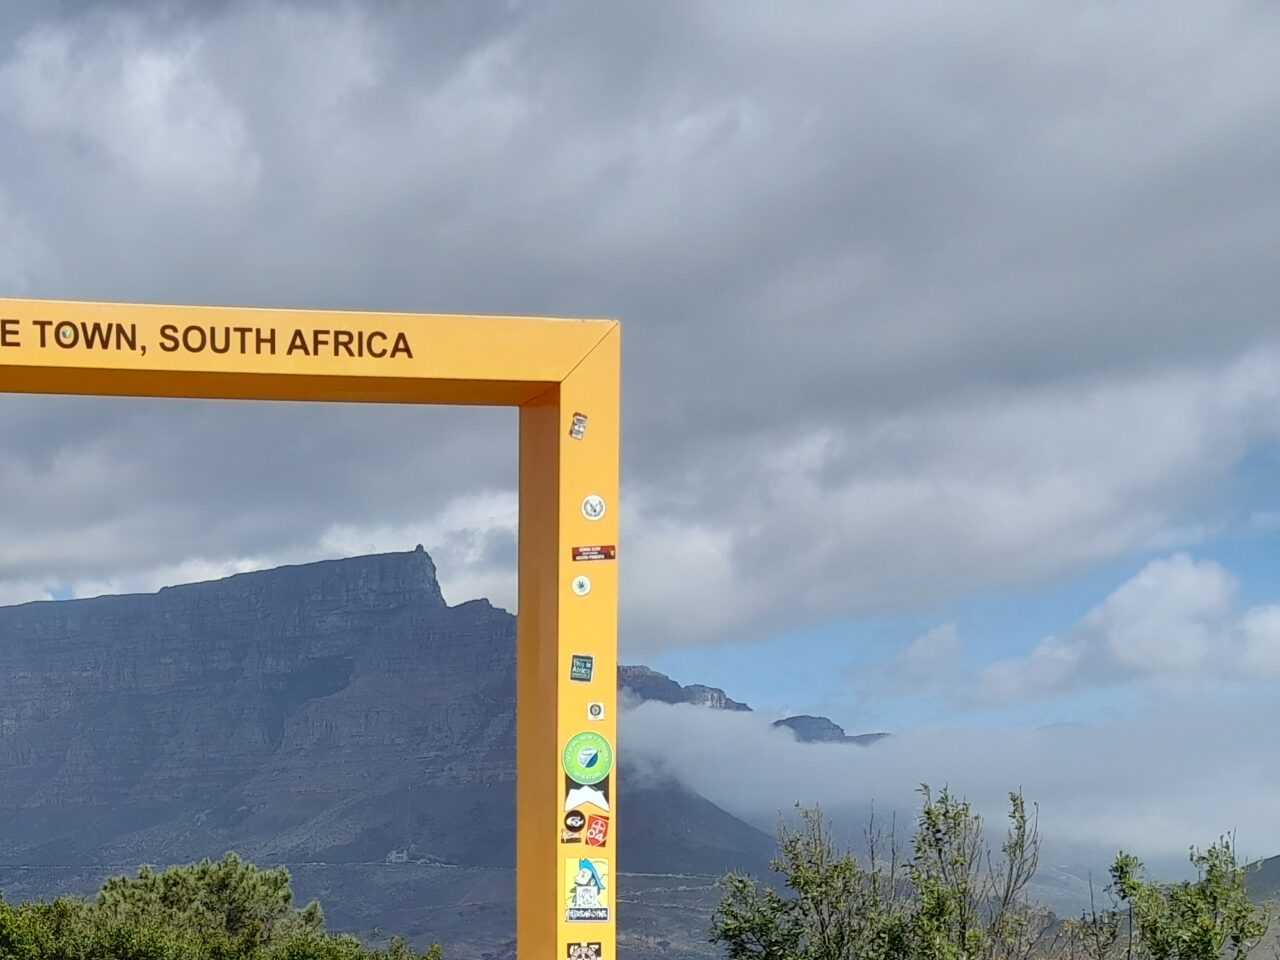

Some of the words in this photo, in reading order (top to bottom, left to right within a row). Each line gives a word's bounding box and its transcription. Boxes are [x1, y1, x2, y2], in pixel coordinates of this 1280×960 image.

[32, 320, 147, 356] TOWN,
[159, 324, 276, 355] SOUTH
[286, 329, 414, 359] AFRICA
